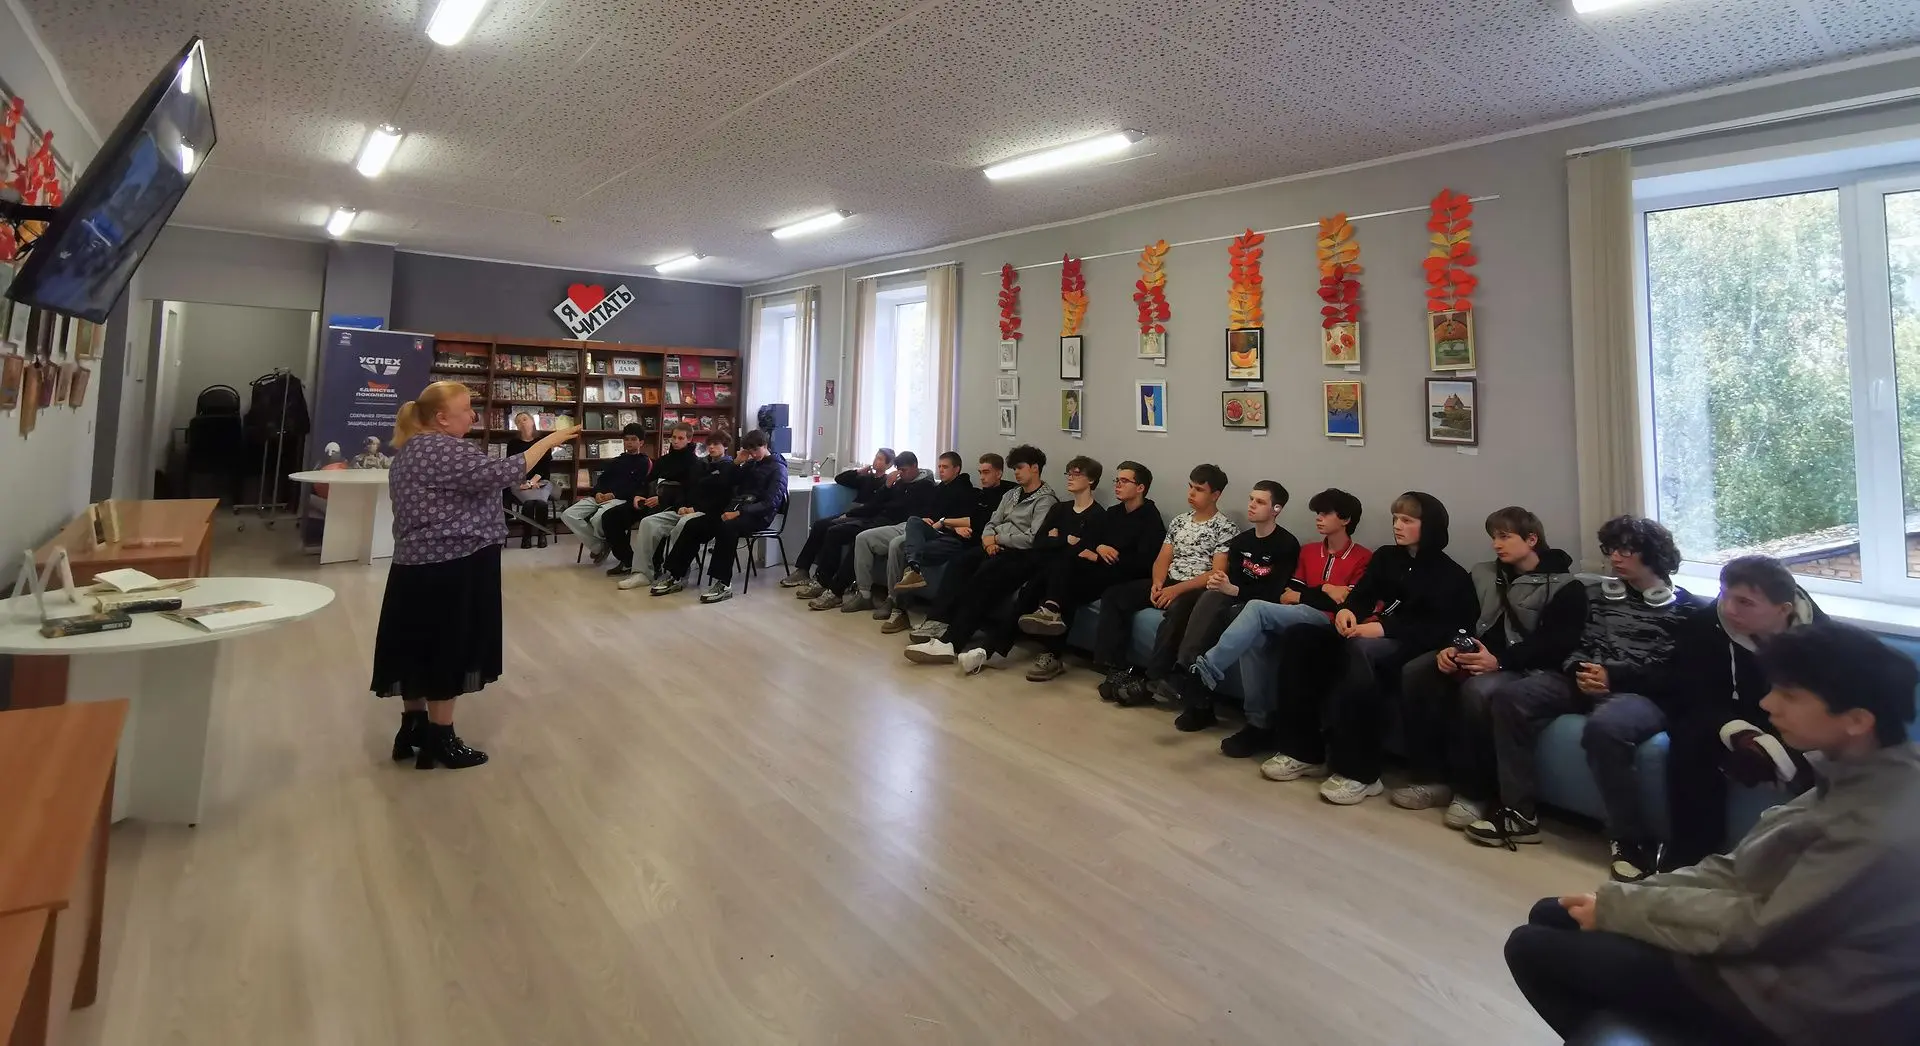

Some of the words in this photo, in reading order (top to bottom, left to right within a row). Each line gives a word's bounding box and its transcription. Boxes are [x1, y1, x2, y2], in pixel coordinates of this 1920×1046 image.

[561, 304, 579, 323] Я
[572, 290, 632, 335] ЧИТАТЬ
[359, 356, 400, 366] УСПЕХ
